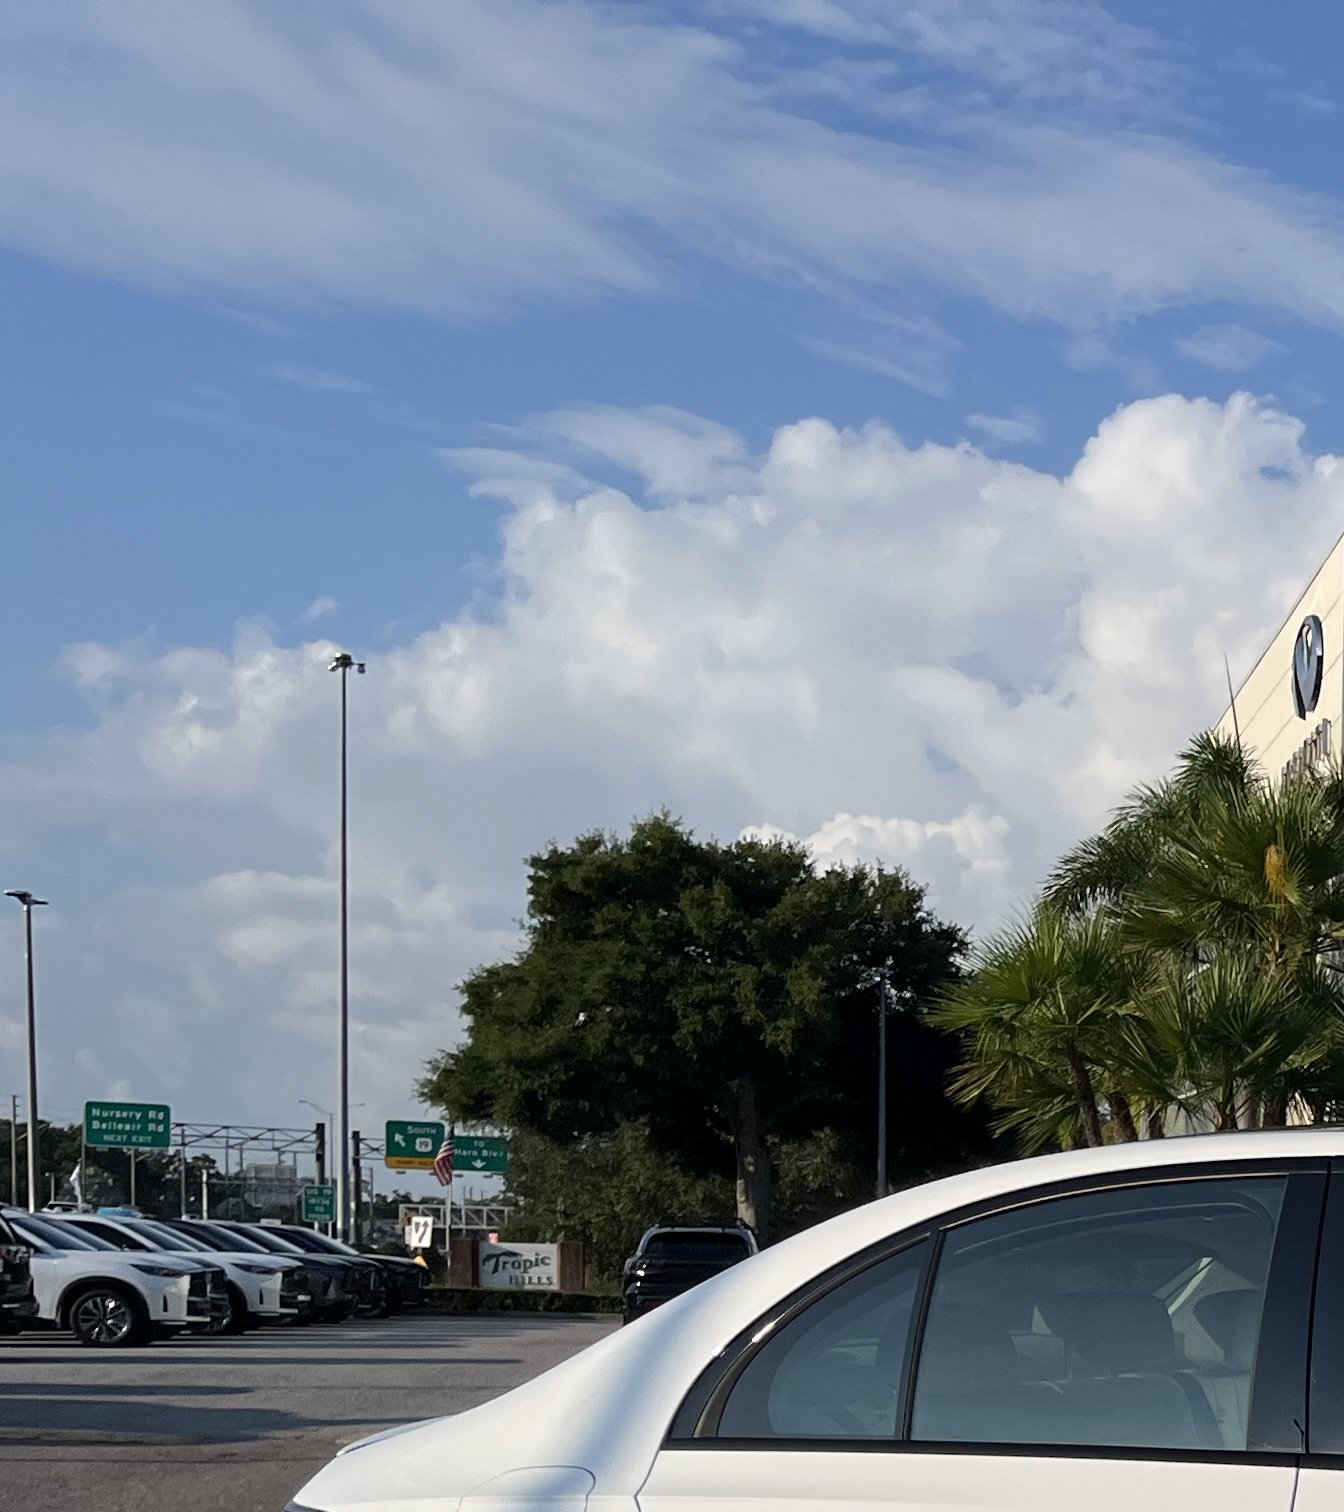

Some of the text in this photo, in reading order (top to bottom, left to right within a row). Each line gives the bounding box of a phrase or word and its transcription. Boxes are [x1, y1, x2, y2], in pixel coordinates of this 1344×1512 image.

[91, 1108, 164, 1120] Nursery Rd
[91, 1120, 164, 1132] Belleair Rd
[406, 1125, 437, 1135] SOUTH
[103, 1134, 152, 1143] NEXT EXIT
[419, 1140, 430, 1149] 19
[473, 1140, 485, 1148] TO
[482, 1250, 552, 1275] Tropic
[509, 1275, 553, 1286] HILLS
